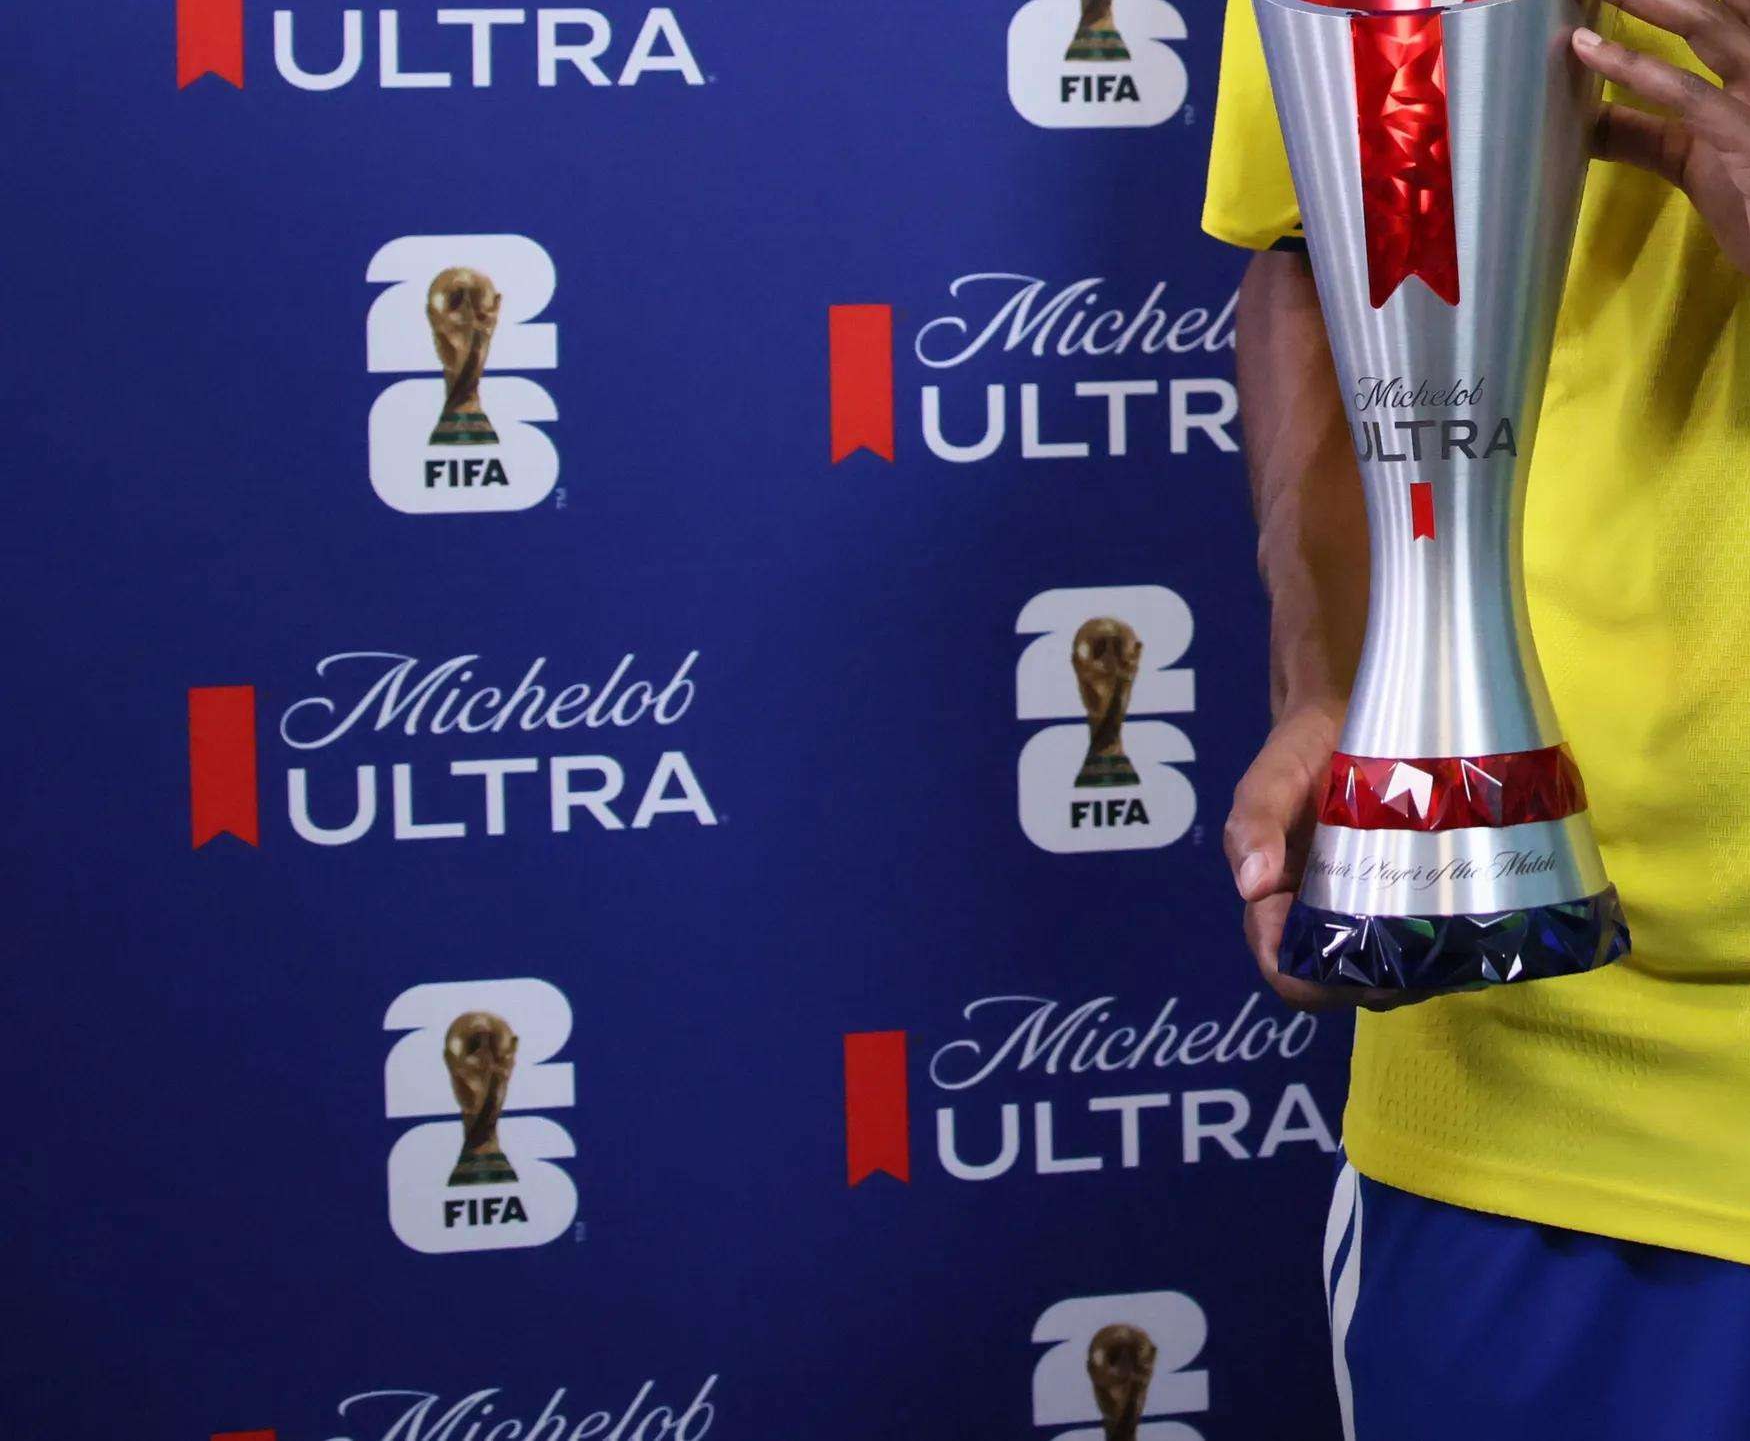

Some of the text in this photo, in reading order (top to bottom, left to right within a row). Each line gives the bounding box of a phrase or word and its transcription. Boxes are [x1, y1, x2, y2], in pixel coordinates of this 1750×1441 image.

[274, 8, 705, 91] ULTRA
[1061, 75, 1140, 102] FIFA
[915, 273, 1236, 368] Michel
[921, 379, 1239, 463] ULTR
[1354, 375, 1487, 412] Michelob
[425, 459, 508, 488] FIFA
[280, 650, 699, 749] Michelob
[288, 752, 717, 845] ULTRA
[1071, 799, 1149, 828] FIFA
[1359, 855, 1421, 890] Player
[1413, 858, 1462, 891] of
[1450, 858, 1479, 881] the
[1491, 849, 1559, 878] Match
[937, 1084, 1336, 1180] ULTRA
[445, 1196, 528, 1228] FIFA
